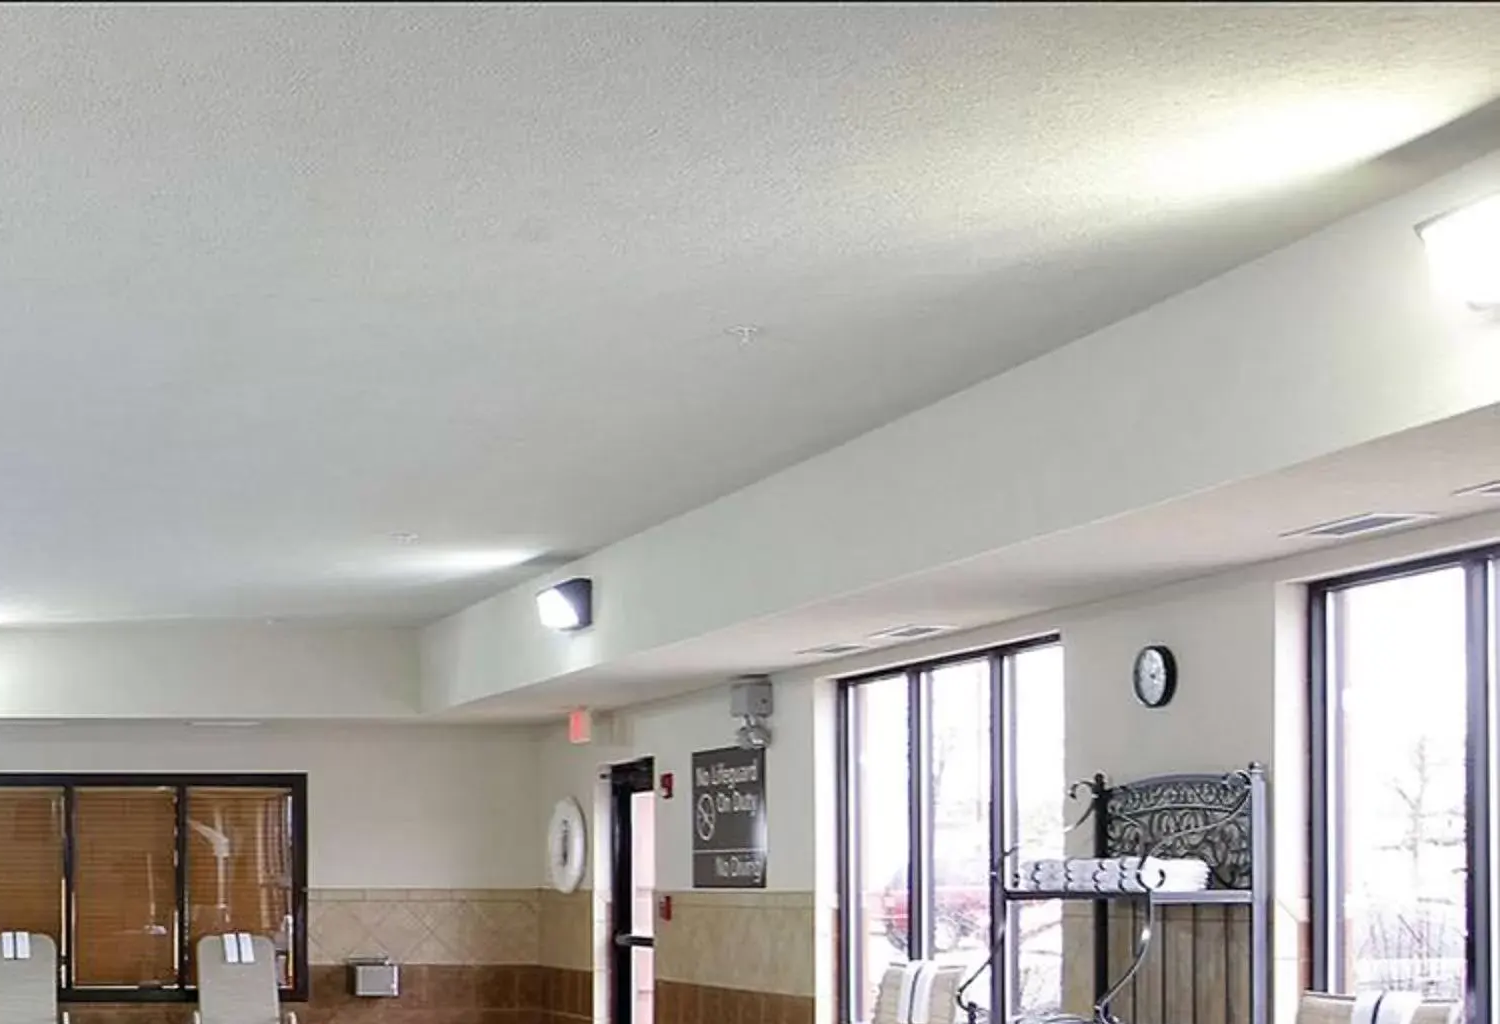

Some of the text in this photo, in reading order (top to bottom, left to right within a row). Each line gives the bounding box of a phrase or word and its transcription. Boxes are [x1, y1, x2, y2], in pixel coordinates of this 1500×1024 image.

[696, 758, 758, 790] No Lifeguard
[715, 856, 762, 883] No Diving
